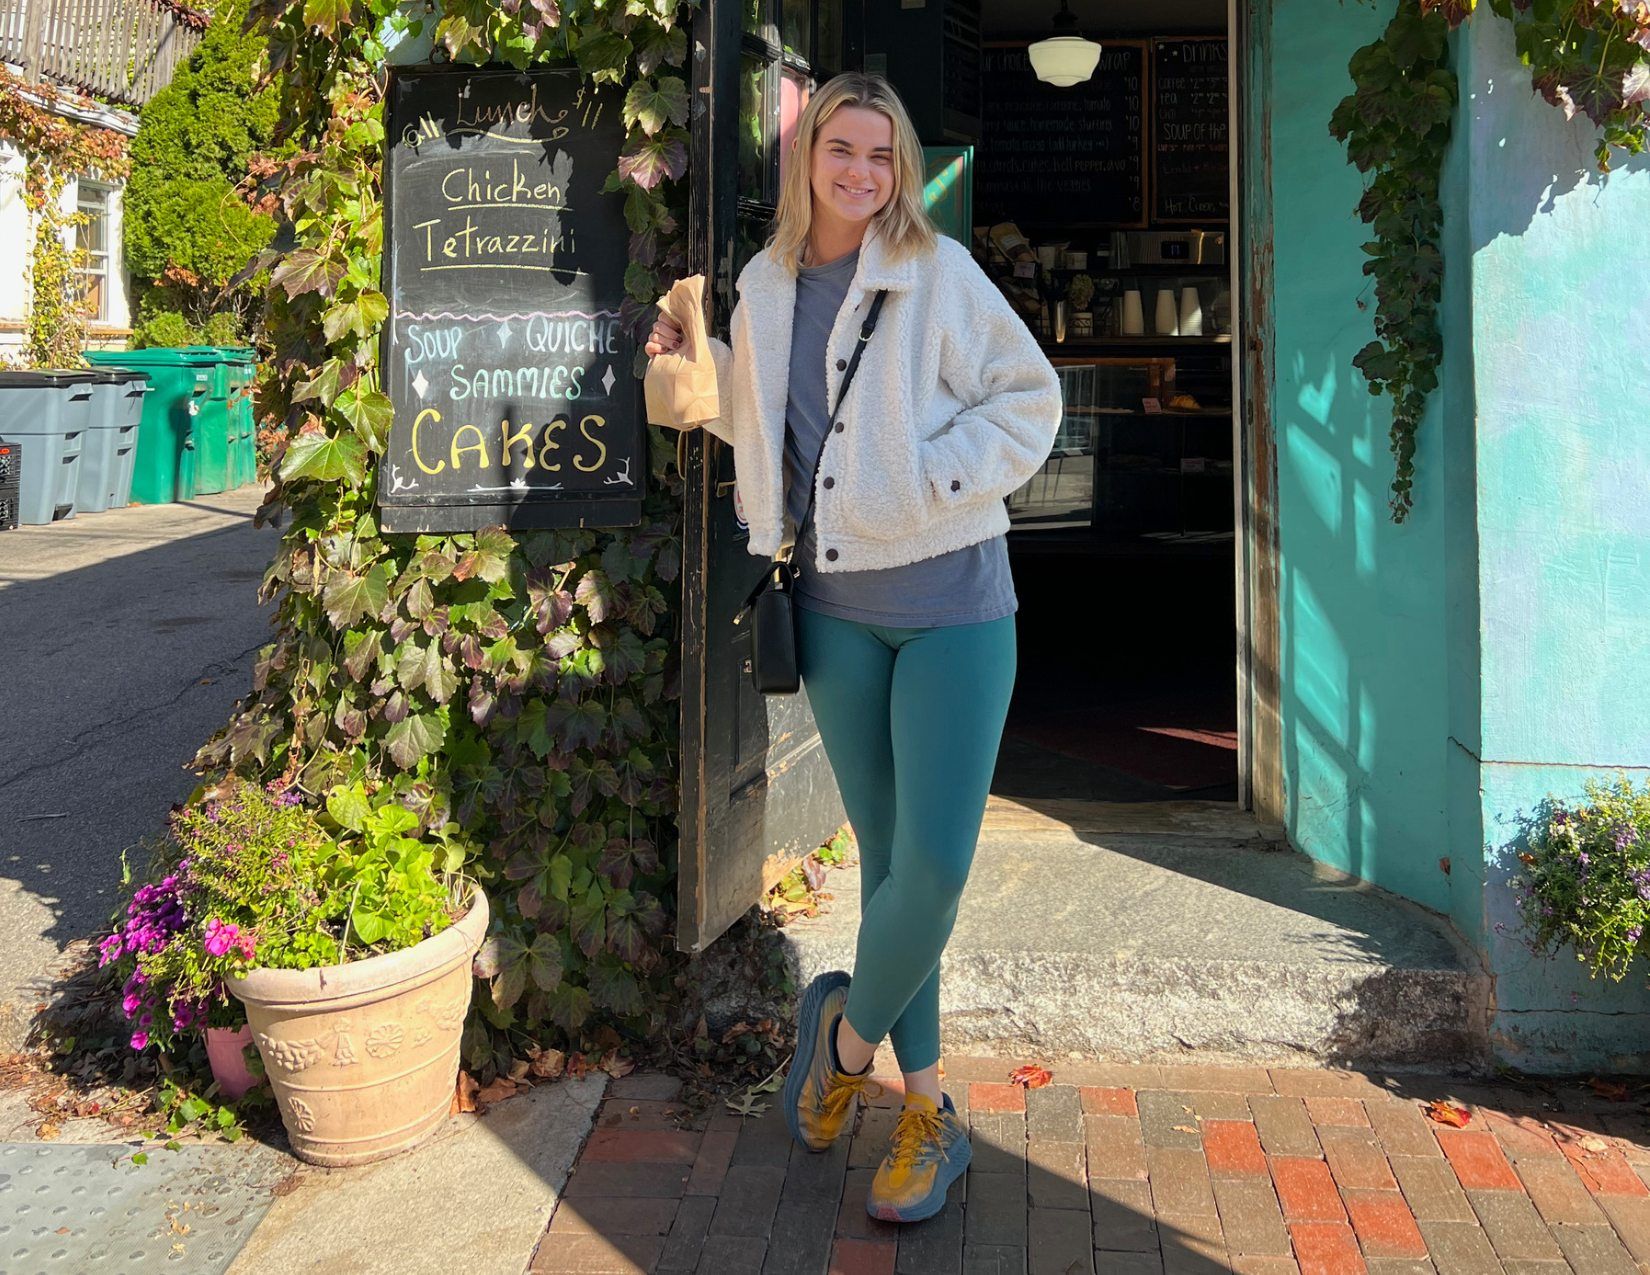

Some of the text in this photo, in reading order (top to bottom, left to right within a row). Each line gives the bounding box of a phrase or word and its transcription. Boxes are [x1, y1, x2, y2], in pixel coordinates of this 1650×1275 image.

[456, 83, 569, 126] Lunch
[441, 158, 561, 203] Chicken
[412, 215, 576, 262] Tetrazzini
[404, 316, 620, 364] SOUP QUICHE
[449, 364, 585, 401] SAMMIES
[411, 408, 607, 475] CAKES
